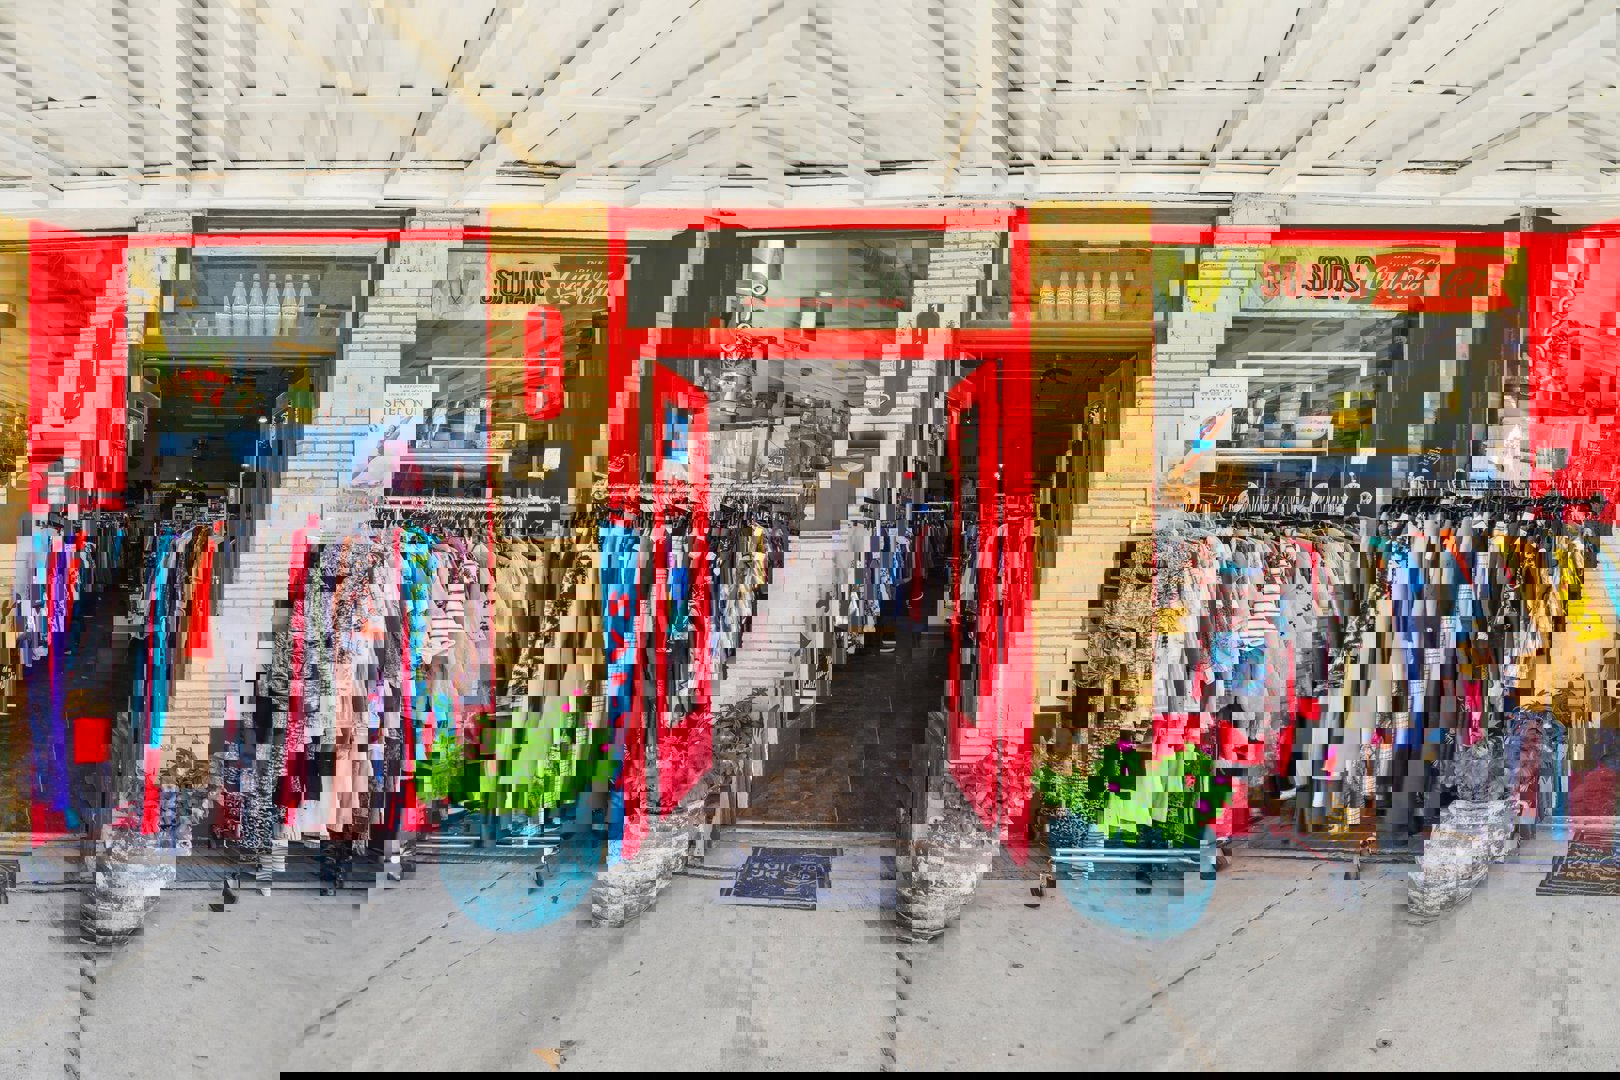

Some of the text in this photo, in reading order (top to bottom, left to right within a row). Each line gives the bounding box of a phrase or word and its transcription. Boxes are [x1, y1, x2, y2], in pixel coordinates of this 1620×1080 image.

[1261, 261, 1497, 301] SODAS Coca-Cola
[165, 283, 186, 375] open
[533, 310, 549, 414] 115
[1168, 397, 1239, 408] SHEN YUN
[667, 671, 694, 693] oliciting
[742, 867, 803, 879] YOUR
[828, 870, 867, 880] SHOP
[737, 877, 802, 887] PLACE
